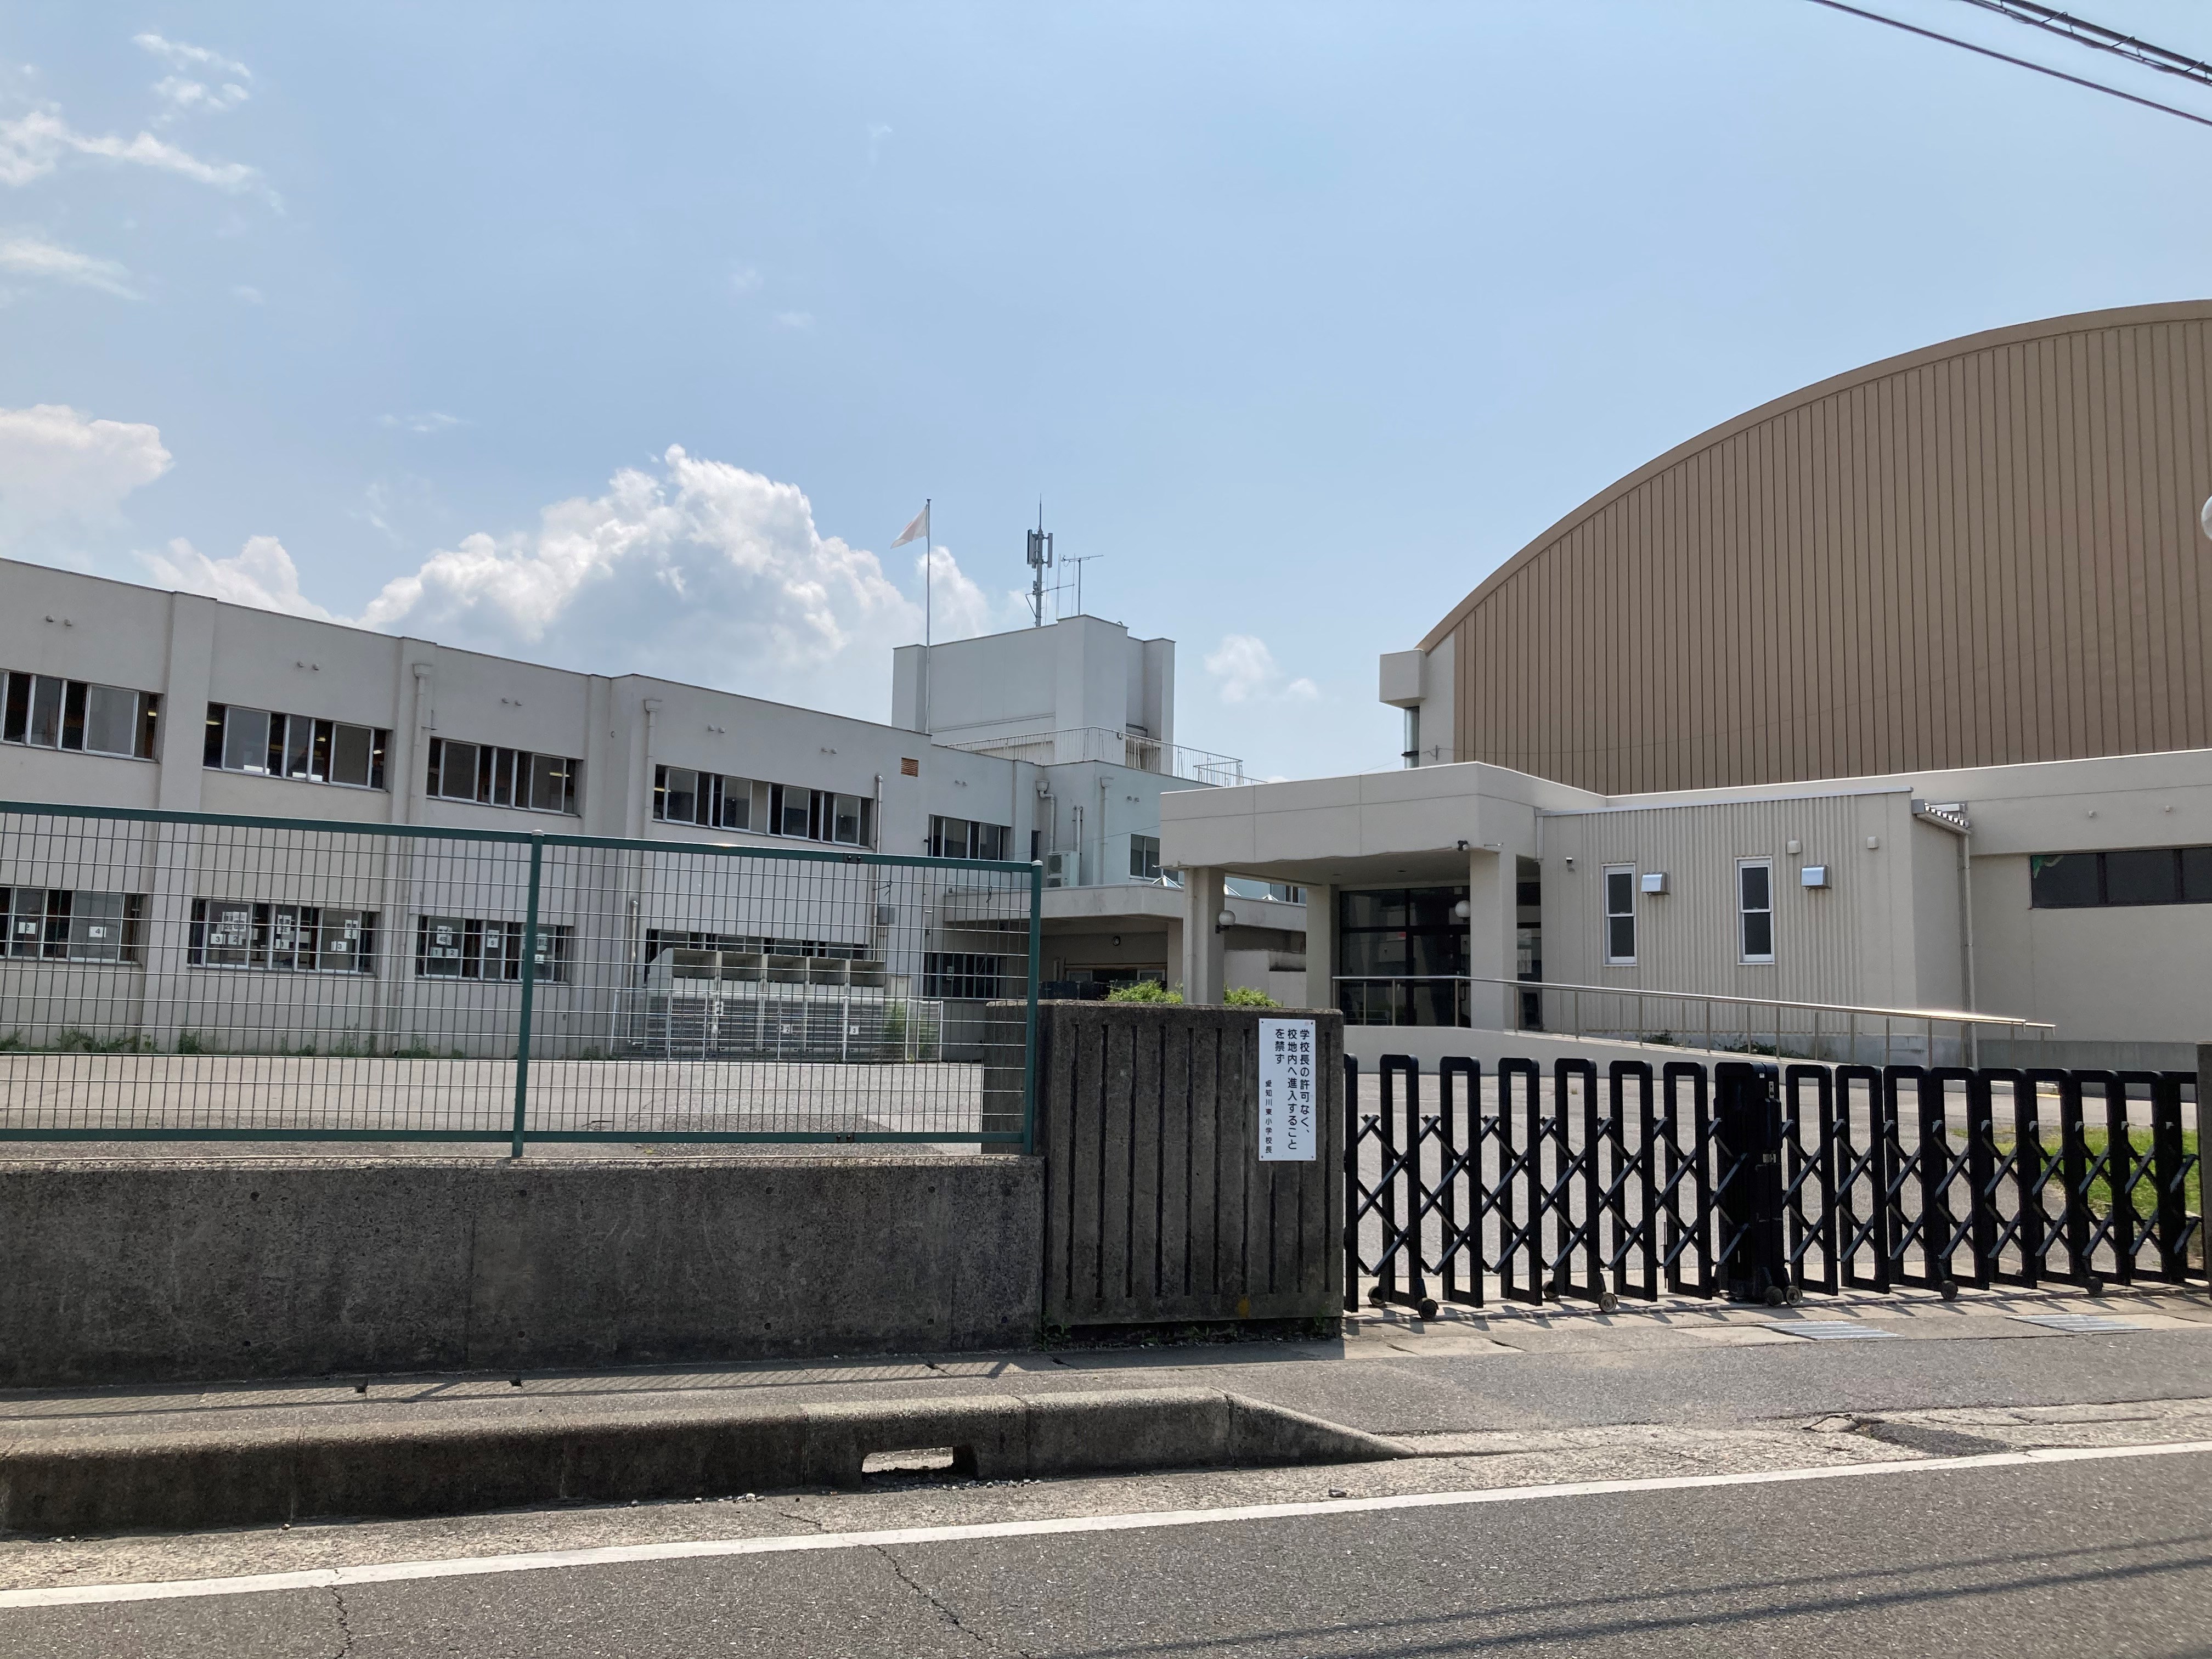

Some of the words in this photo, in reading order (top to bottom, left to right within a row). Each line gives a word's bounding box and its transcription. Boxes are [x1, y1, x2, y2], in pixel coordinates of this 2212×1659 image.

[1287, 1028, 1297, 1150] 校地内へ進入すること
[1300, 1029, 1310, 1133] 学校長の許可なく、
